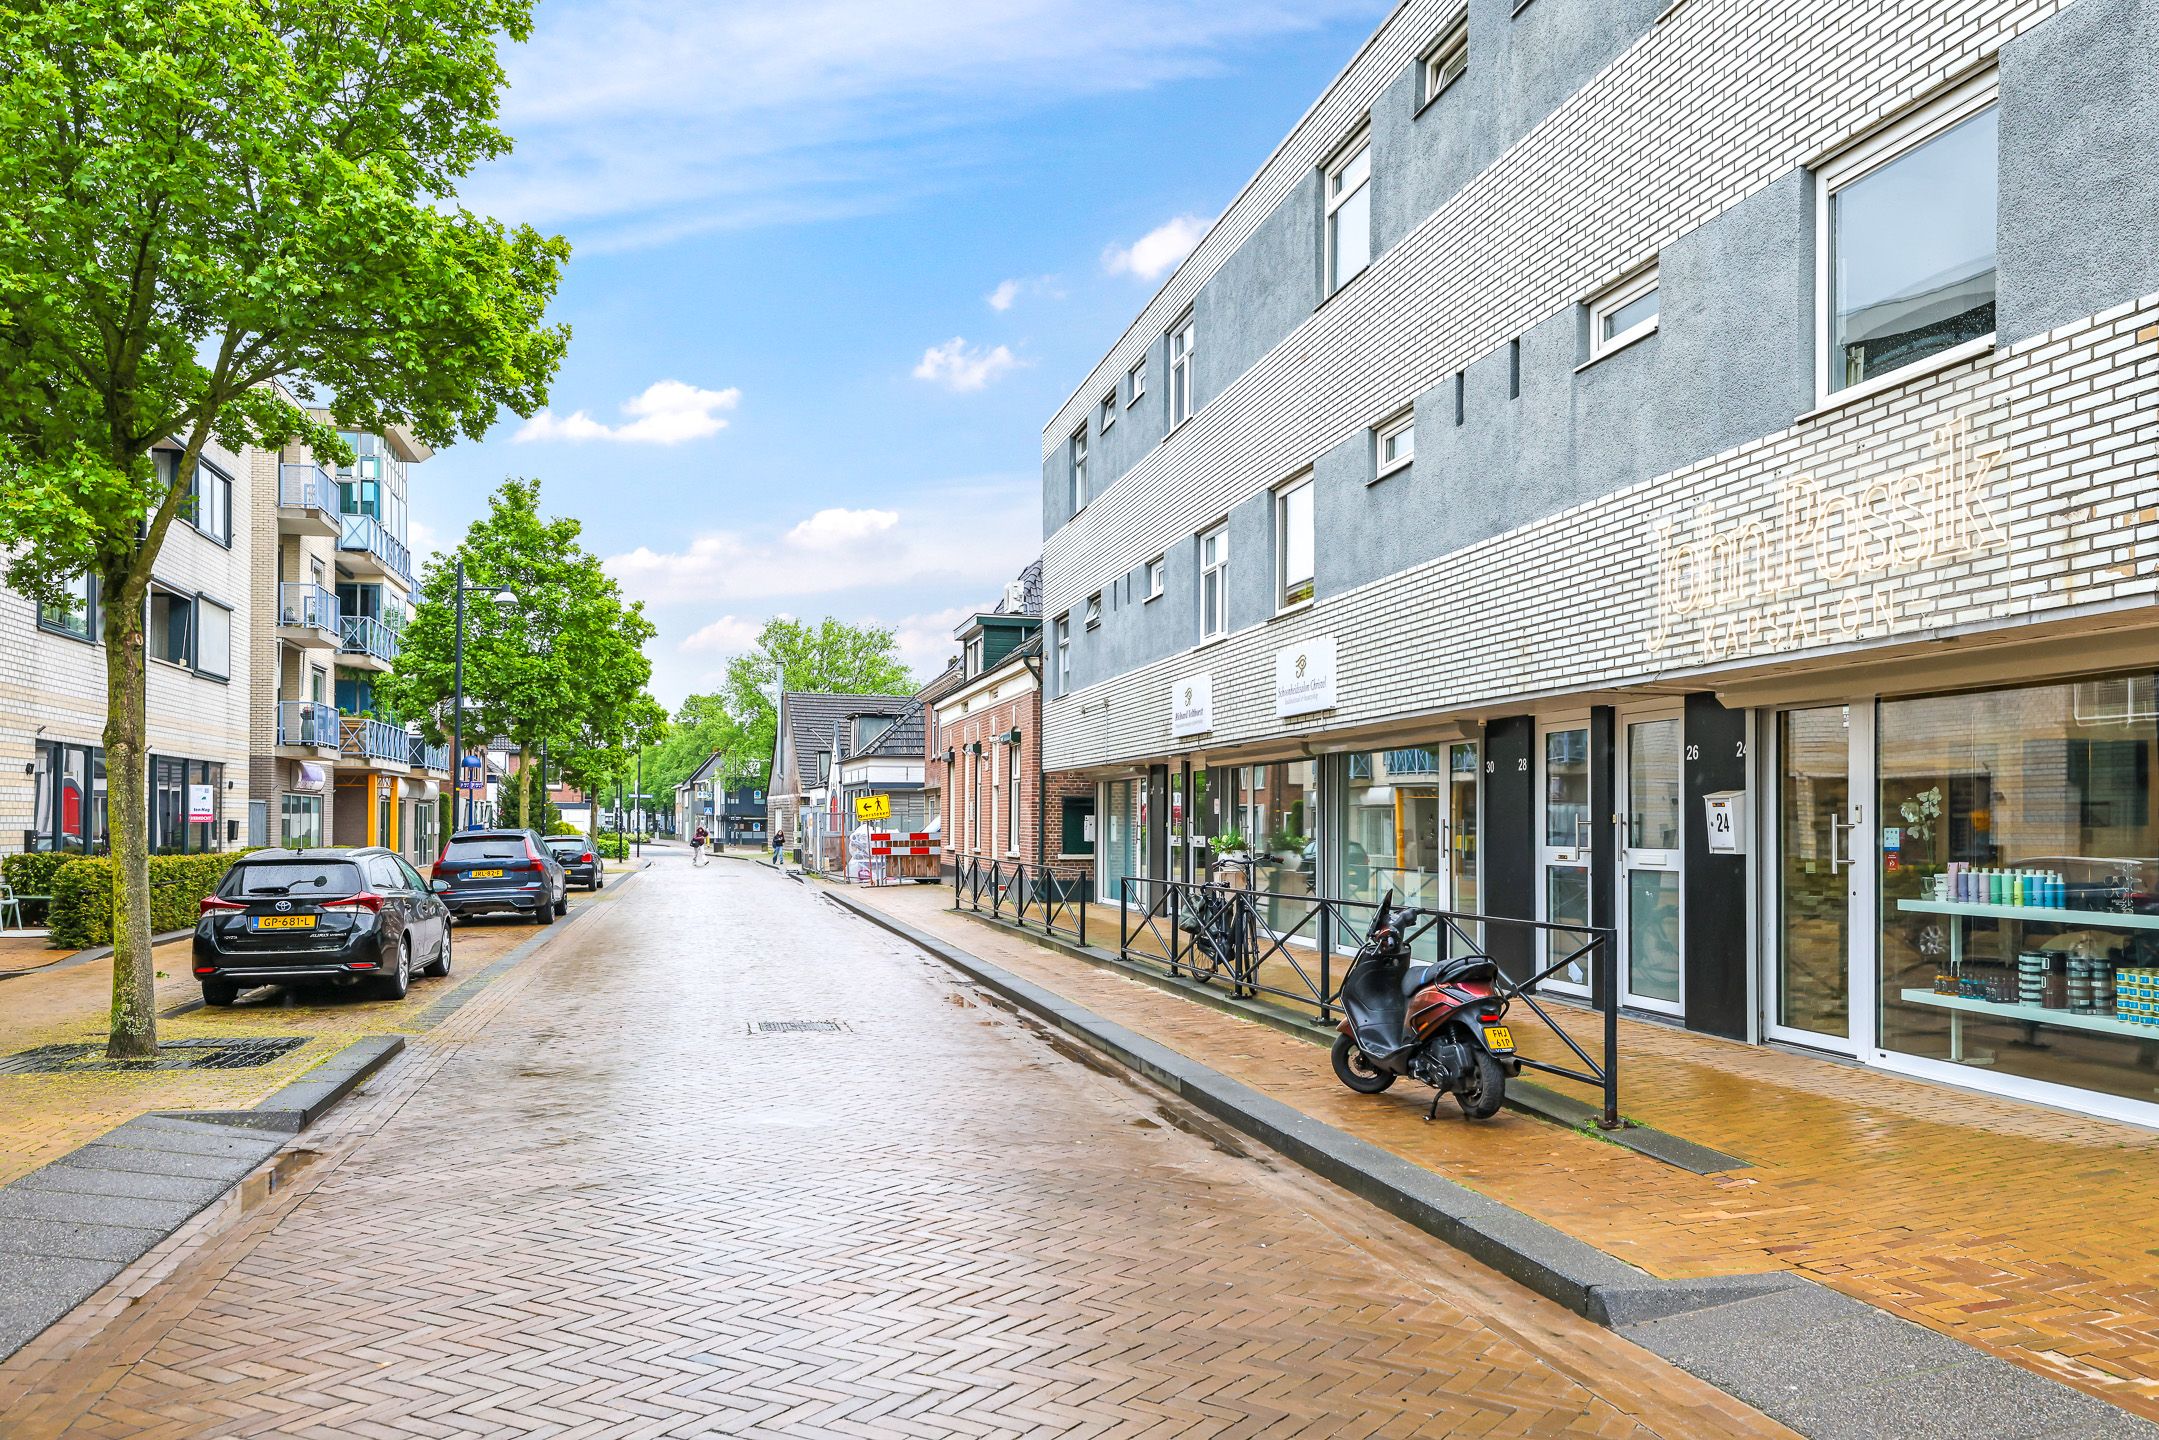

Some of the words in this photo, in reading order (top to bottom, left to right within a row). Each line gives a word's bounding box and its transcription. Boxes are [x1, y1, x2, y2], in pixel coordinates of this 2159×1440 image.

[1645, 502, 1776, 652] John
[1704, 587, 1895, 656] KAPSALON
[1686, 744, 1698, 760] 26
[1486, 760, 1494, 773] 30
[1518, 758, 1527, 771] 28
[1716, 812, 1730, 832] 24
[264, 917, 310, 926] GP-681-L
[1492, 1030, 1507, 1038] FHJ
[1496, 1038, 1510, 1046] 61P
